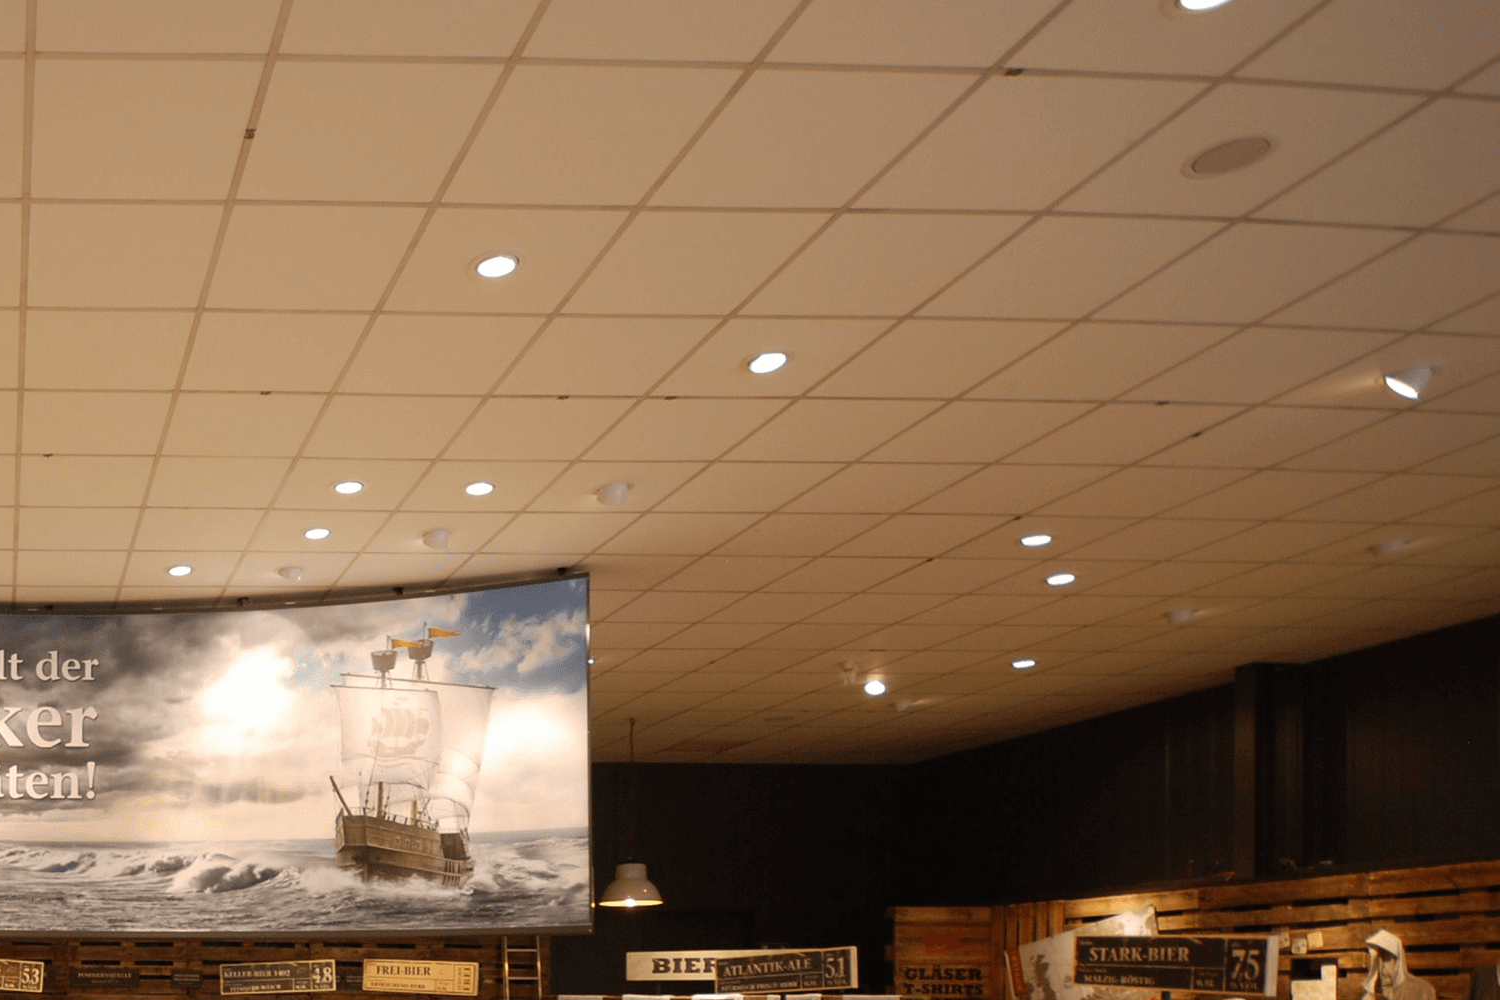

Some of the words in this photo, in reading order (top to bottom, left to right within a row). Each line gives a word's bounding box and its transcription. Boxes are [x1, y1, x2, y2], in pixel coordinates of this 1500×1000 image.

[36, 651, 99, 681] der
[1089, 946, 1190, 962] STARK-BIER
[376, 965, 431, 976] FREI-BIER
[724, 958, 812, 978] ATLANTIK-ALE
[905, 965, 982, 980] GLÄSER
[904, 983, 983, 995] T-SHIRTS
